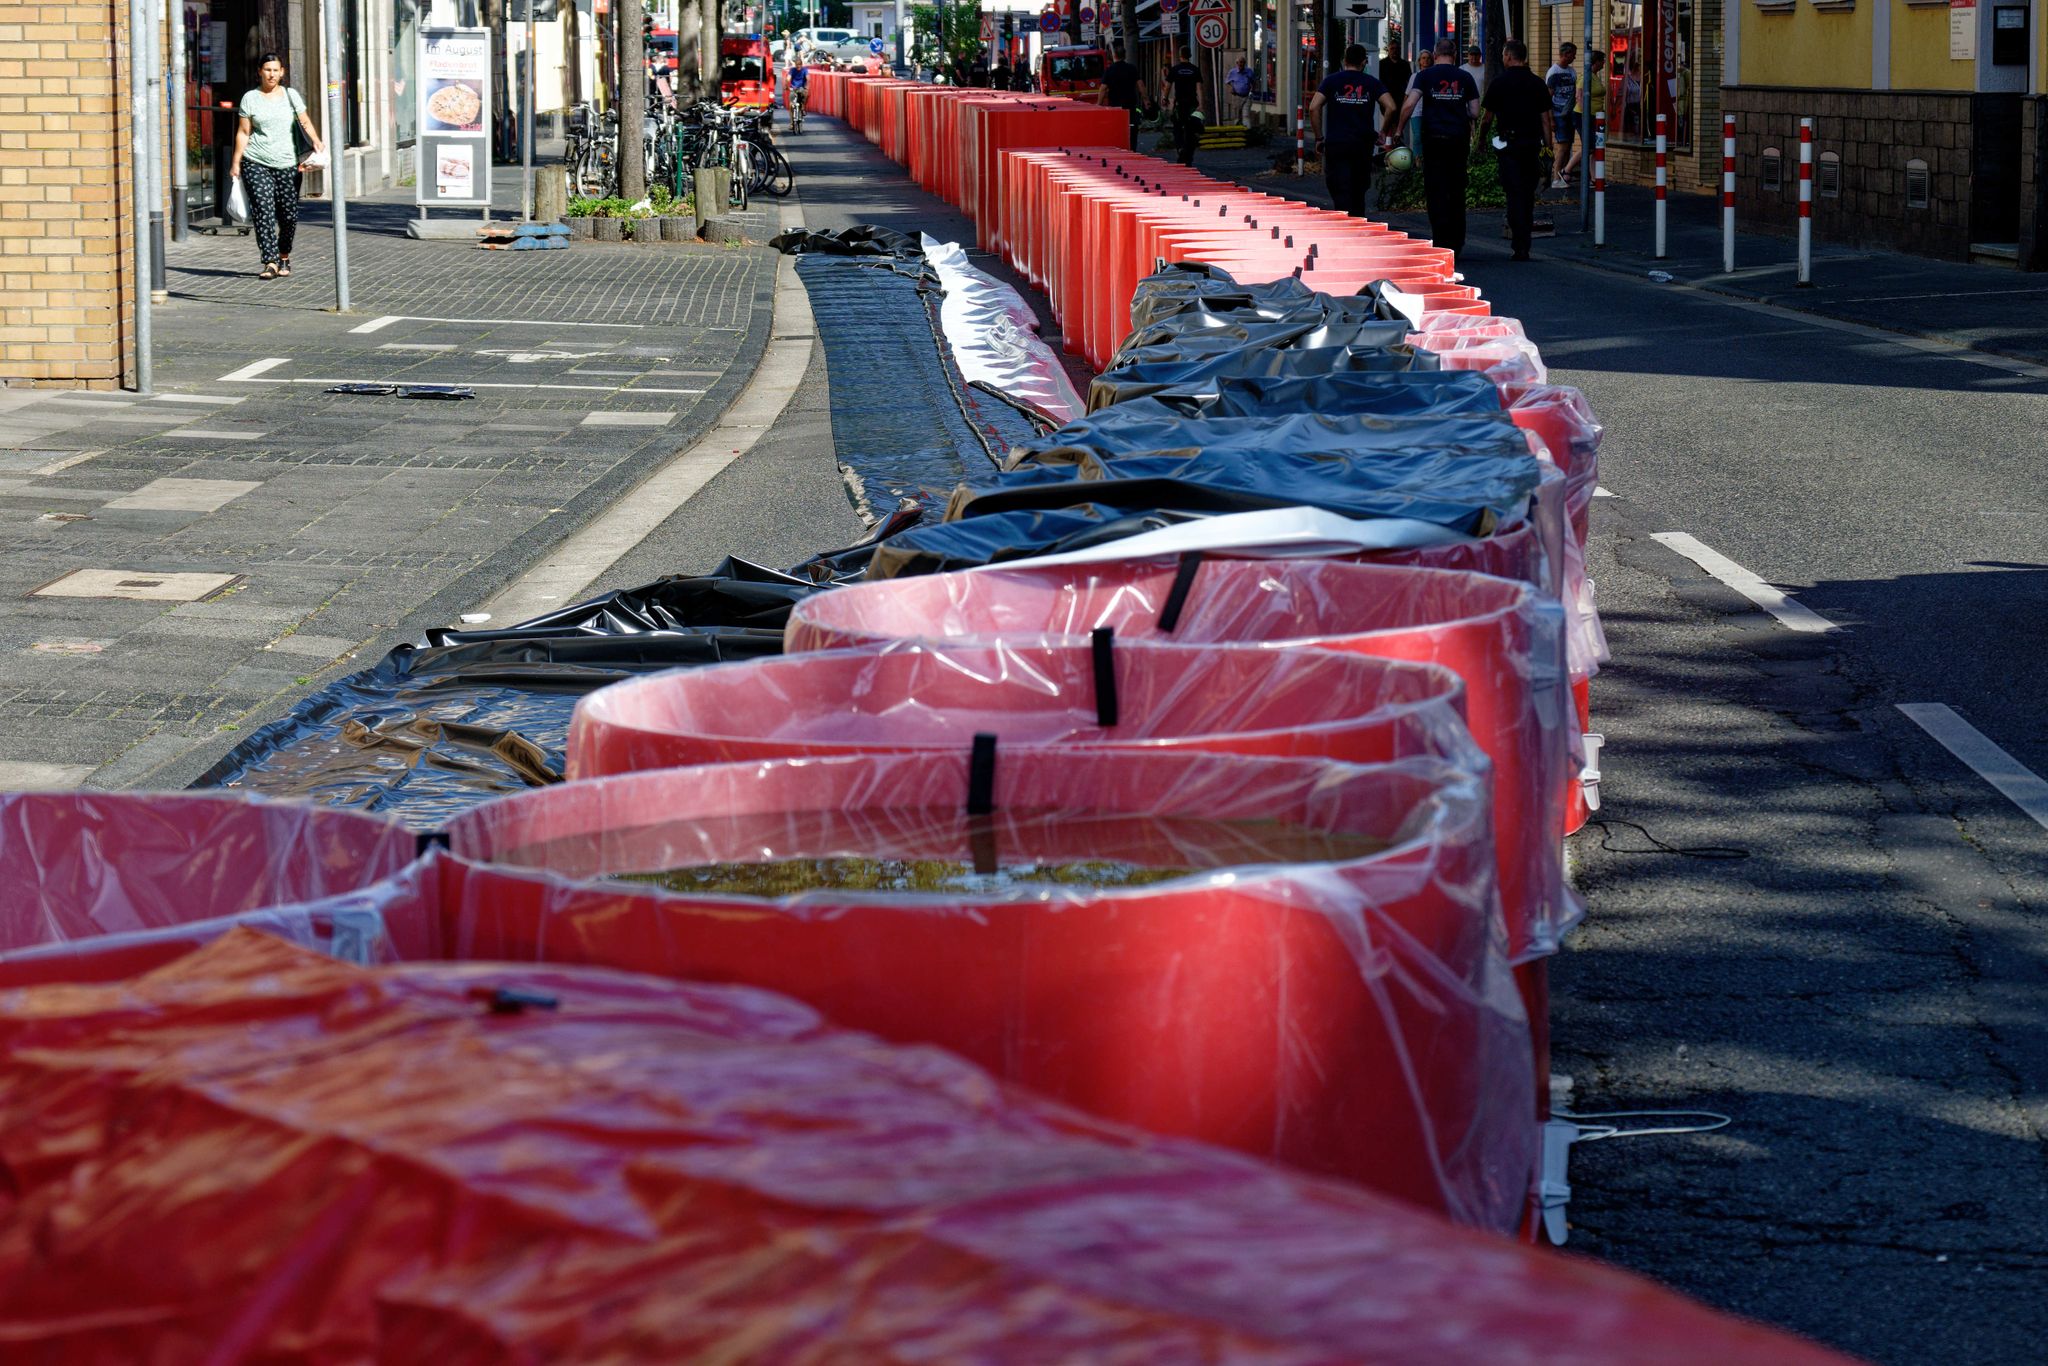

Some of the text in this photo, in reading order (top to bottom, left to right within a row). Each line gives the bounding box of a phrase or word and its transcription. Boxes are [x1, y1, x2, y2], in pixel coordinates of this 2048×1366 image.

[1202, 23, 1221, 39] 30
[1661, 0, 1674, 74] cervél
[425, 43, 482, 57] Im August
[1343, 83, 1364, 99] 21
[1439, 79, 1460, 95] 21
